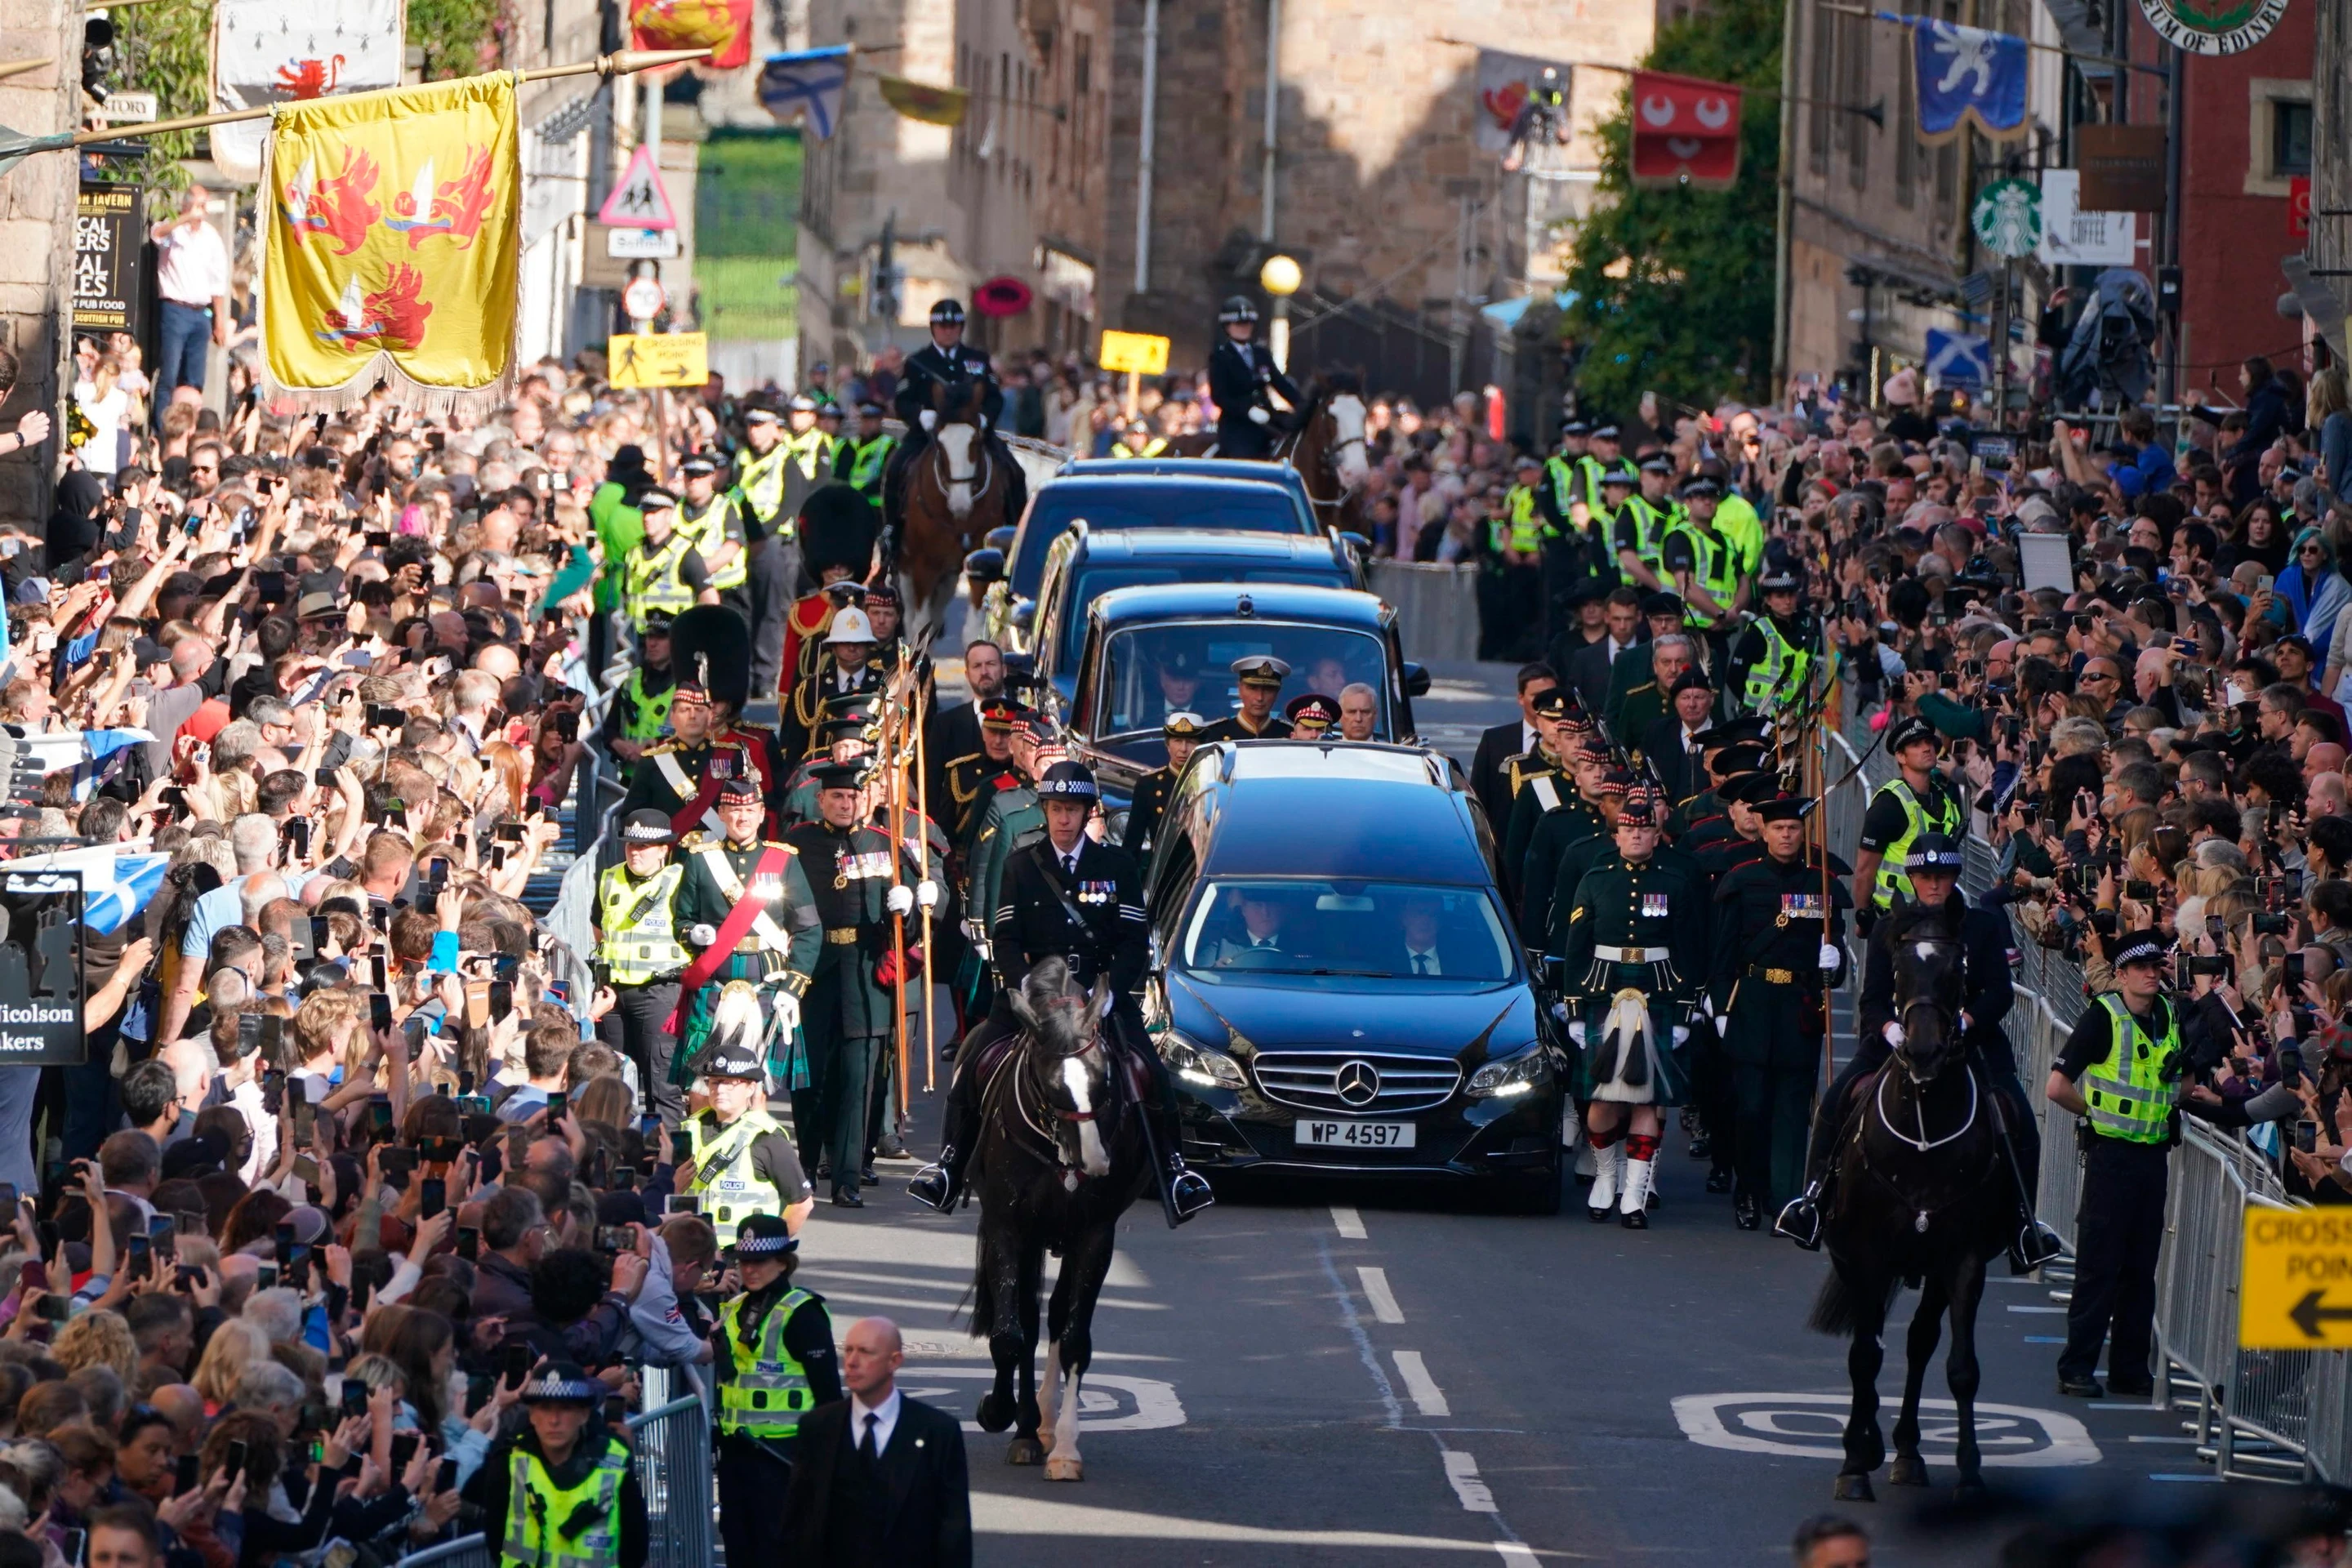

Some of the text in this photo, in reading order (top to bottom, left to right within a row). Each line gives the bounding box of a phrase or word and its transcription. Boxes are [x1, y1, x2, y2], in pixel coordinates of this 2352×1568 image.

[2183, 33, 2207, 51] OF
[93, 194, 131, 207] TAVERN
[79, 299, 97, 309] PUB
[99, 300, 126, 310] FOOD
[74, 314, 125, 324] SCOTTISH PUB
[645, 919, 666, 927] POLICE
[0, 1003, 74, 1023] icolson
[0, 1031, 44, 1051] kers
[1312, 1123, 1401, 1145] WP 4597
[720, 1181, 744, 1190] POLICE
